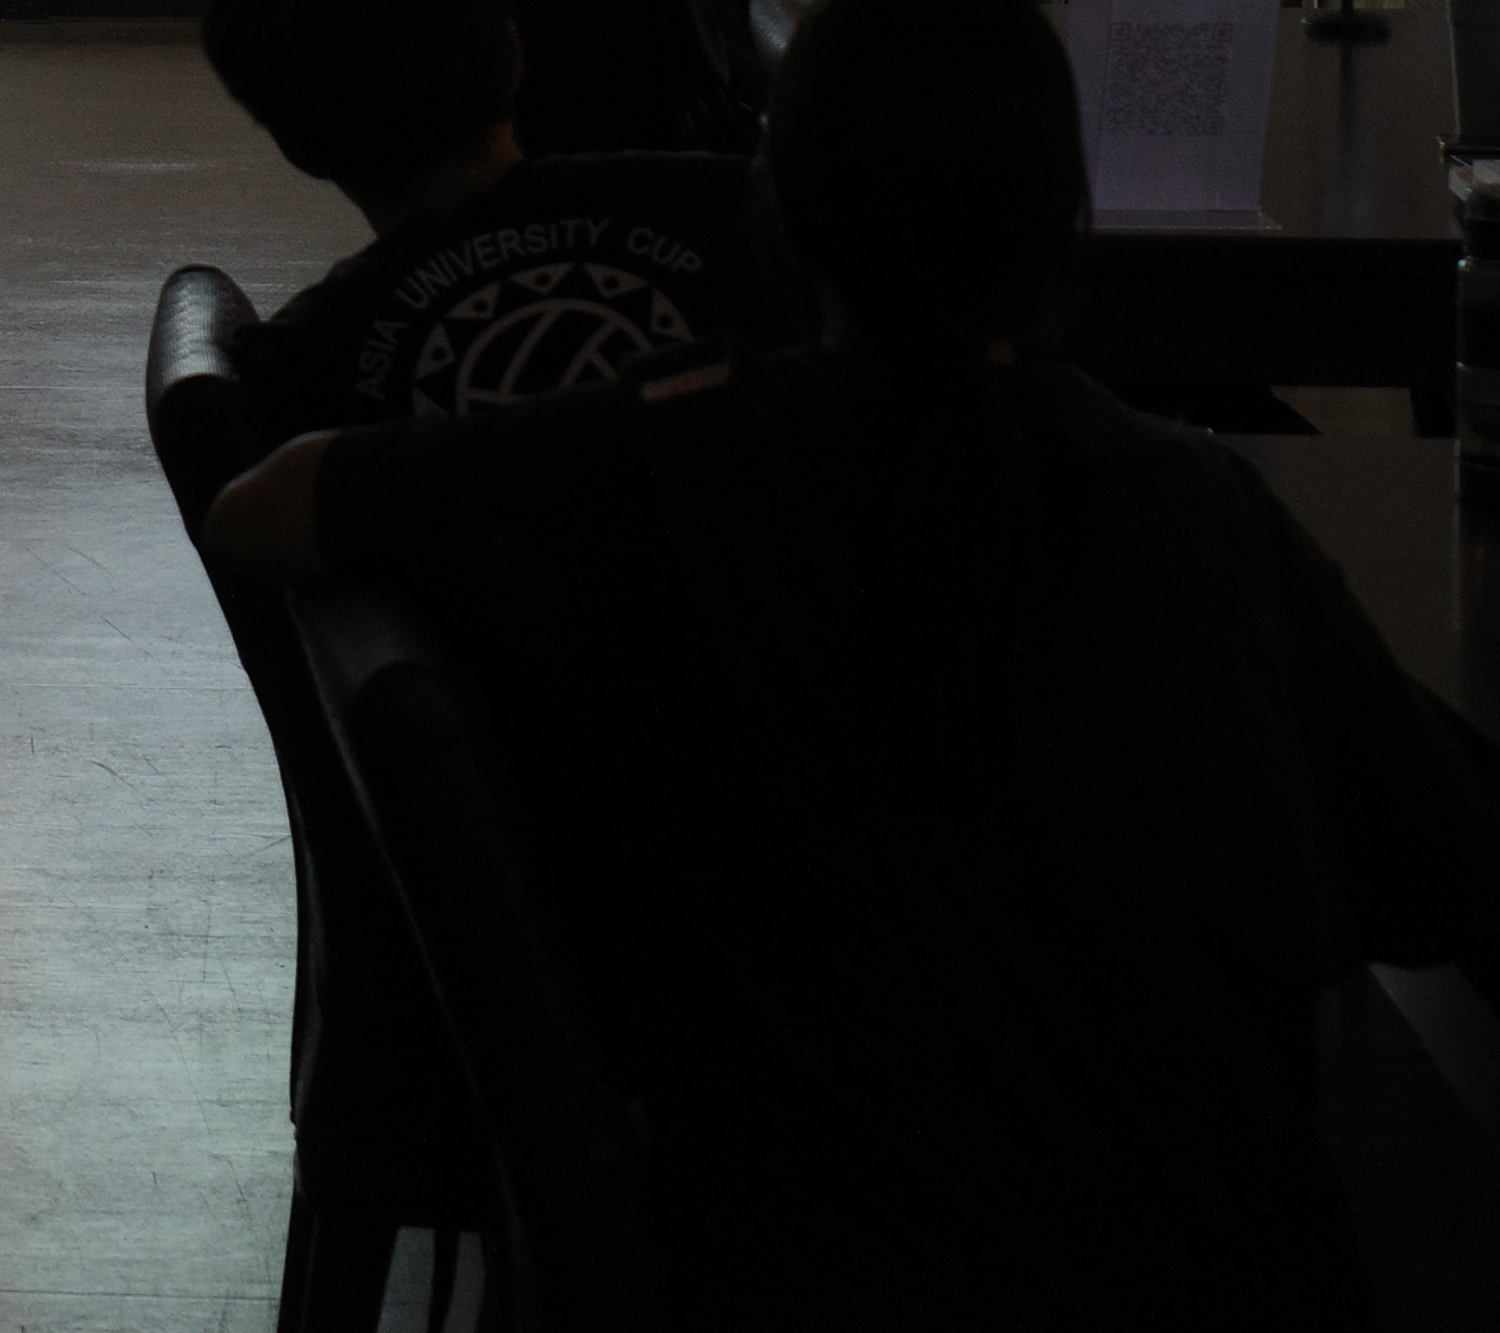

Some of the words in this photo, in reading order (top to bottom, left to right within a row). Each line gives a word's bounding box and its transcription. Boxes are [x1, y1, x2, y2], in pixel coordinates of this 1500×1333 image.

[354, 319, 408, 401] ASIA
[393, 217, 612, 311] UNIVERSITY
[626, 226, 704, 278] CUP
